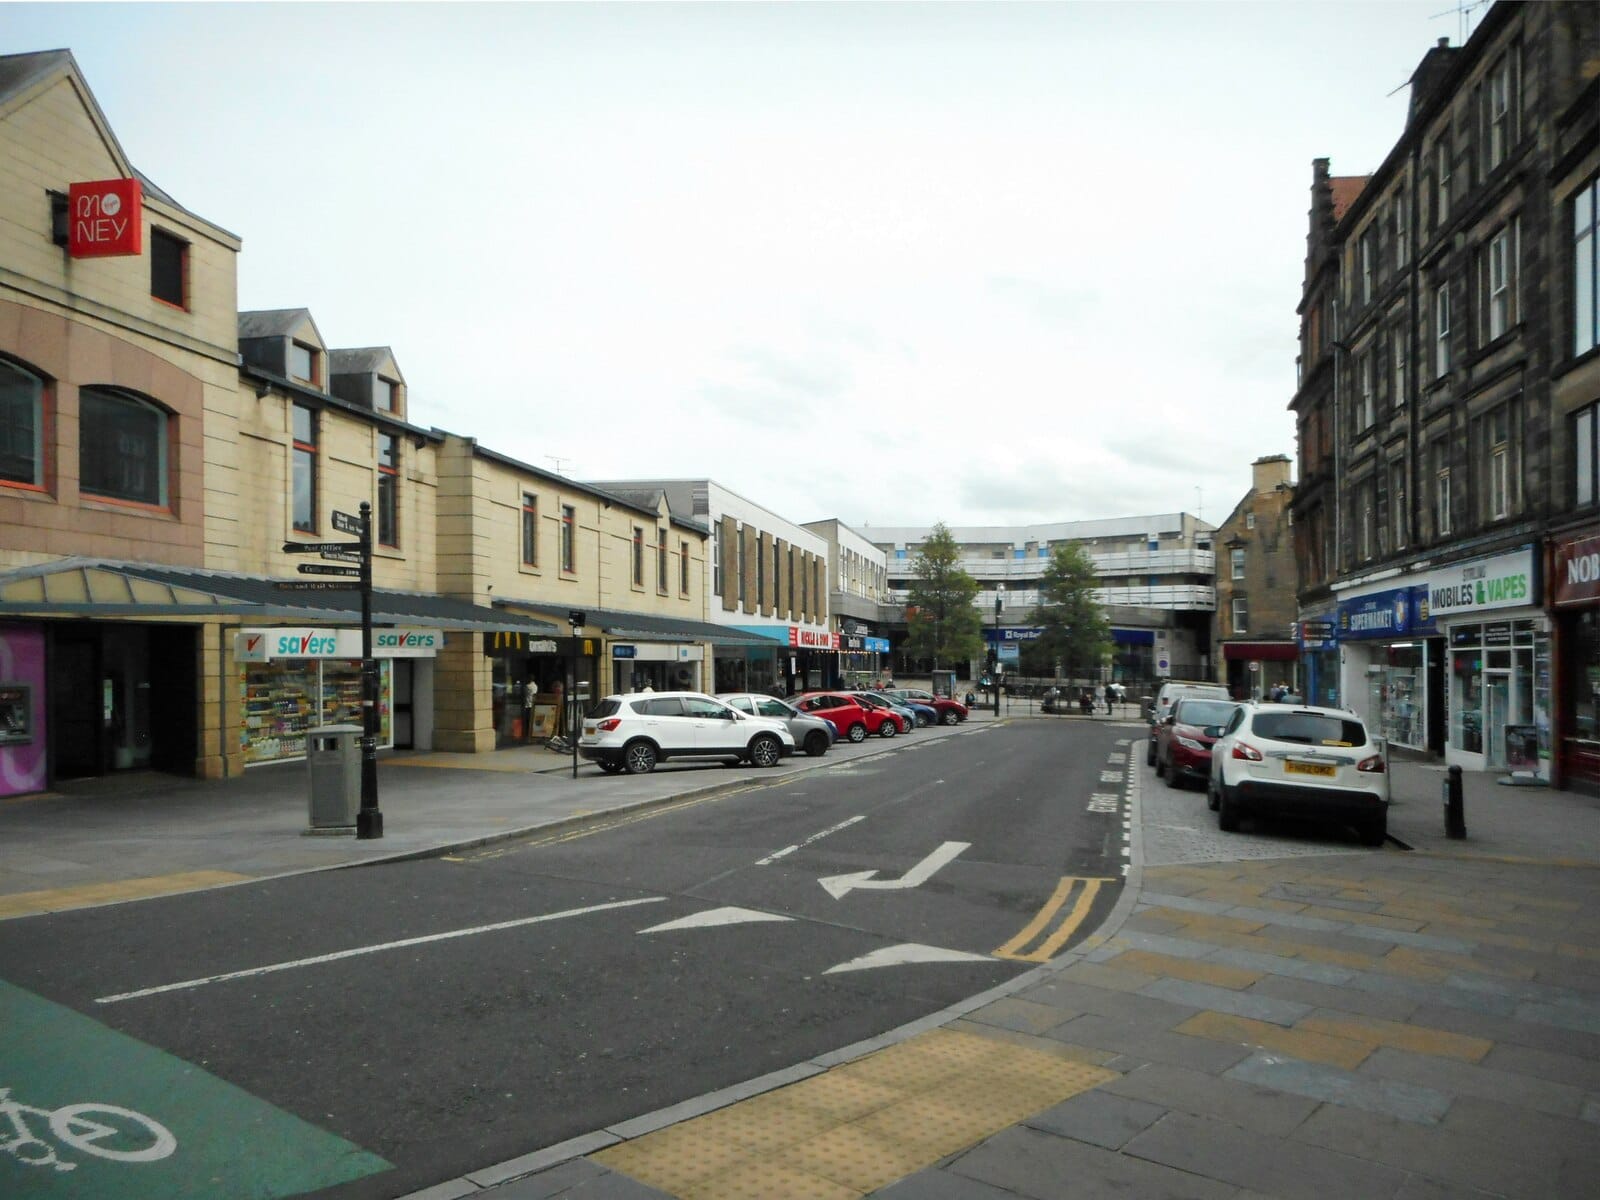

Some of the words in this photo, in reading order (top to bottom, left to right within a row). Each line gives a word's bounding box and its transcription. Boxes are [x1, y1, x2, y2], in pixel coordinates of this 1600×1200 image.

[77, 218, 128, 243] NEY
[1431, 583, 1473, 610] MOBILES
[1487, 574, 1527, 601] VAPES
[1351, 609, 1393, 631] SUPERMARKET
[278, 631, 336, 654] savers
[377, 631, 434, 647] savers
[1013, 631, 1029, 639] Royal
